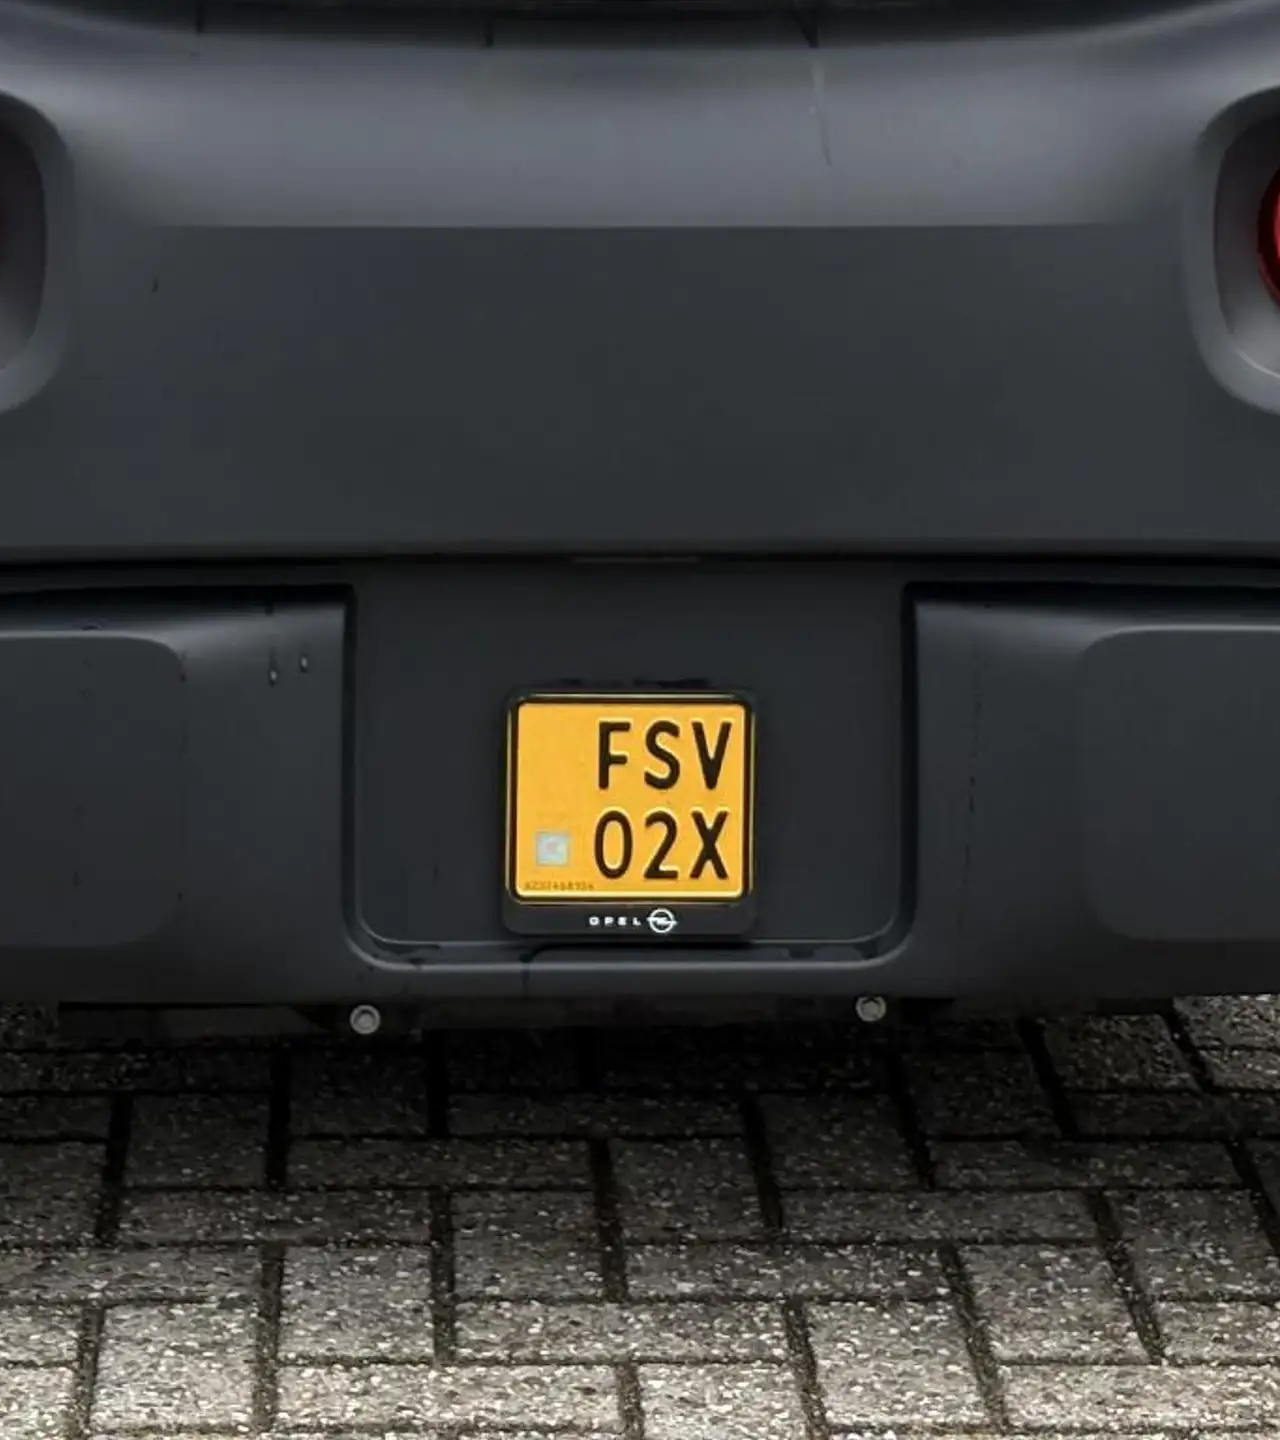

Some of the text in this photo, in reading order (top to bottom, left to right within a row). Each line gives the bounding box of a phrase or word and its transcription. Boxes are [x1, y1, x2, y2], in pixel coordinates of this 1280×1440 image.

[597, 720, 733, 791] FSV
[593, 809, 729, 880] 02X
[588, 915, 642, 927] OPEL
